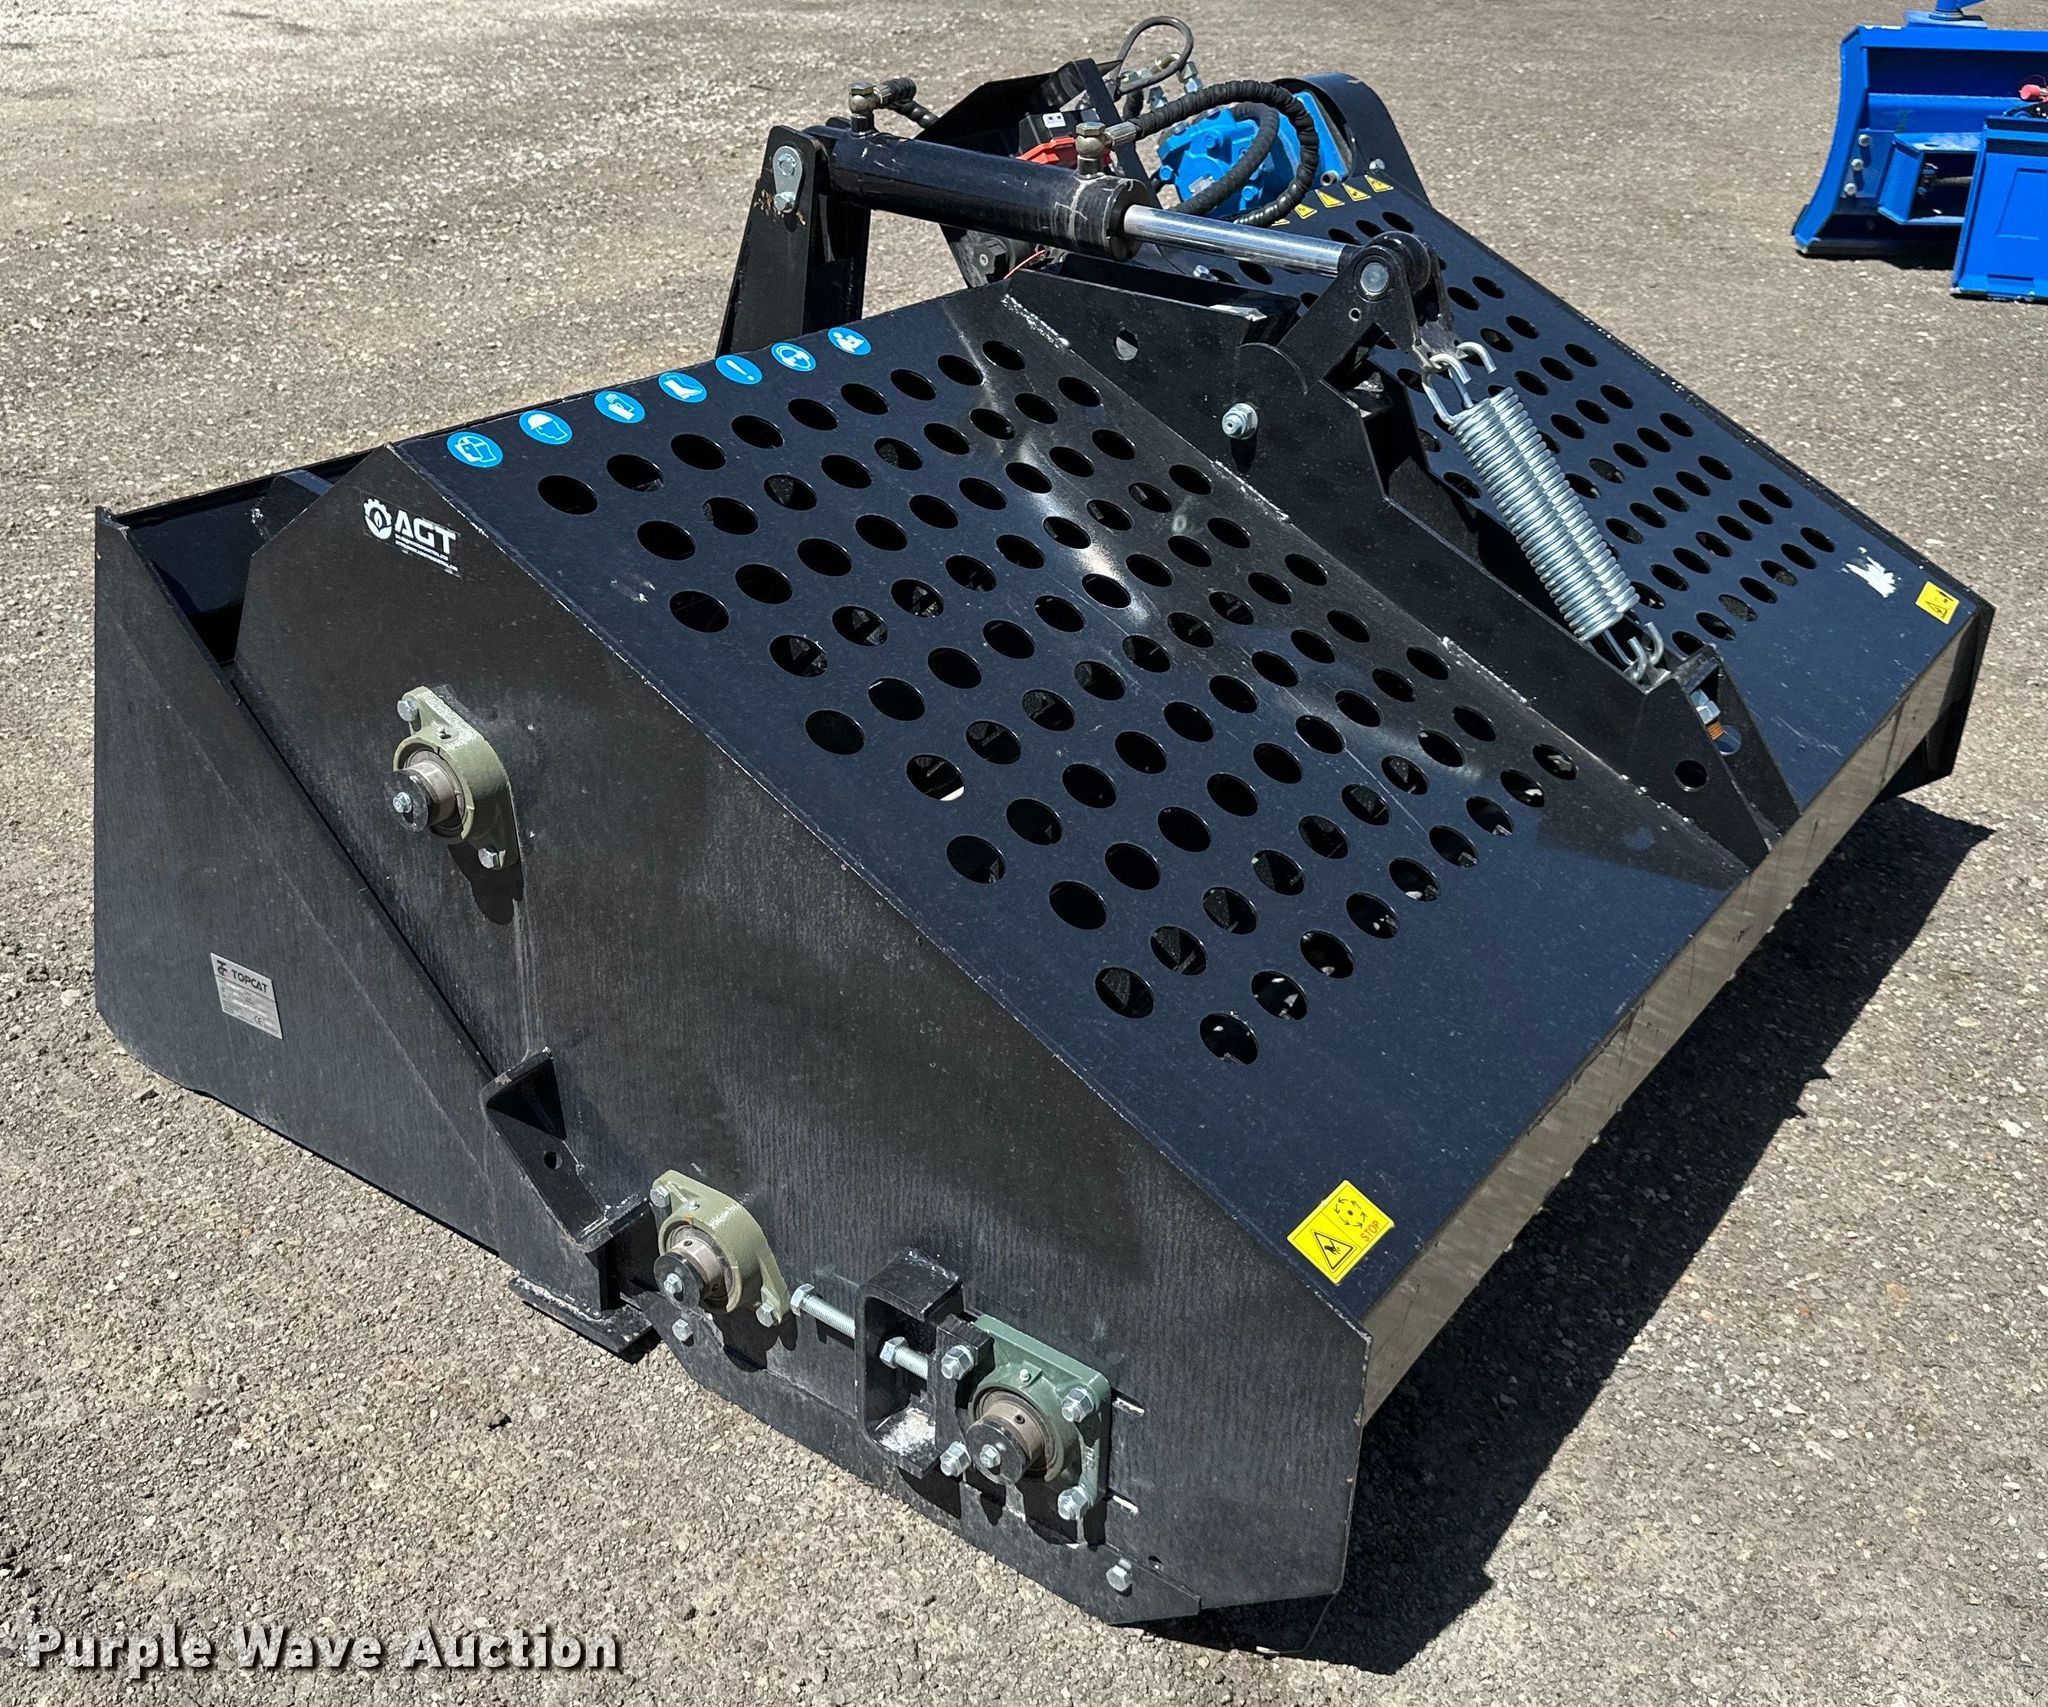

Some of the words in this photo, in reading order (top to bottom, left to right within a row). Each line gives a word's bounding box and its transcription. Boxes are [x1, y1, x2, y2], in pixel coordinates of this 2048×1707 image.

[394, 509, 456, 554] AGT
[231, 969, 268, 993] TOPCAT
[1360, 1220, 1380, 1242] STOP
